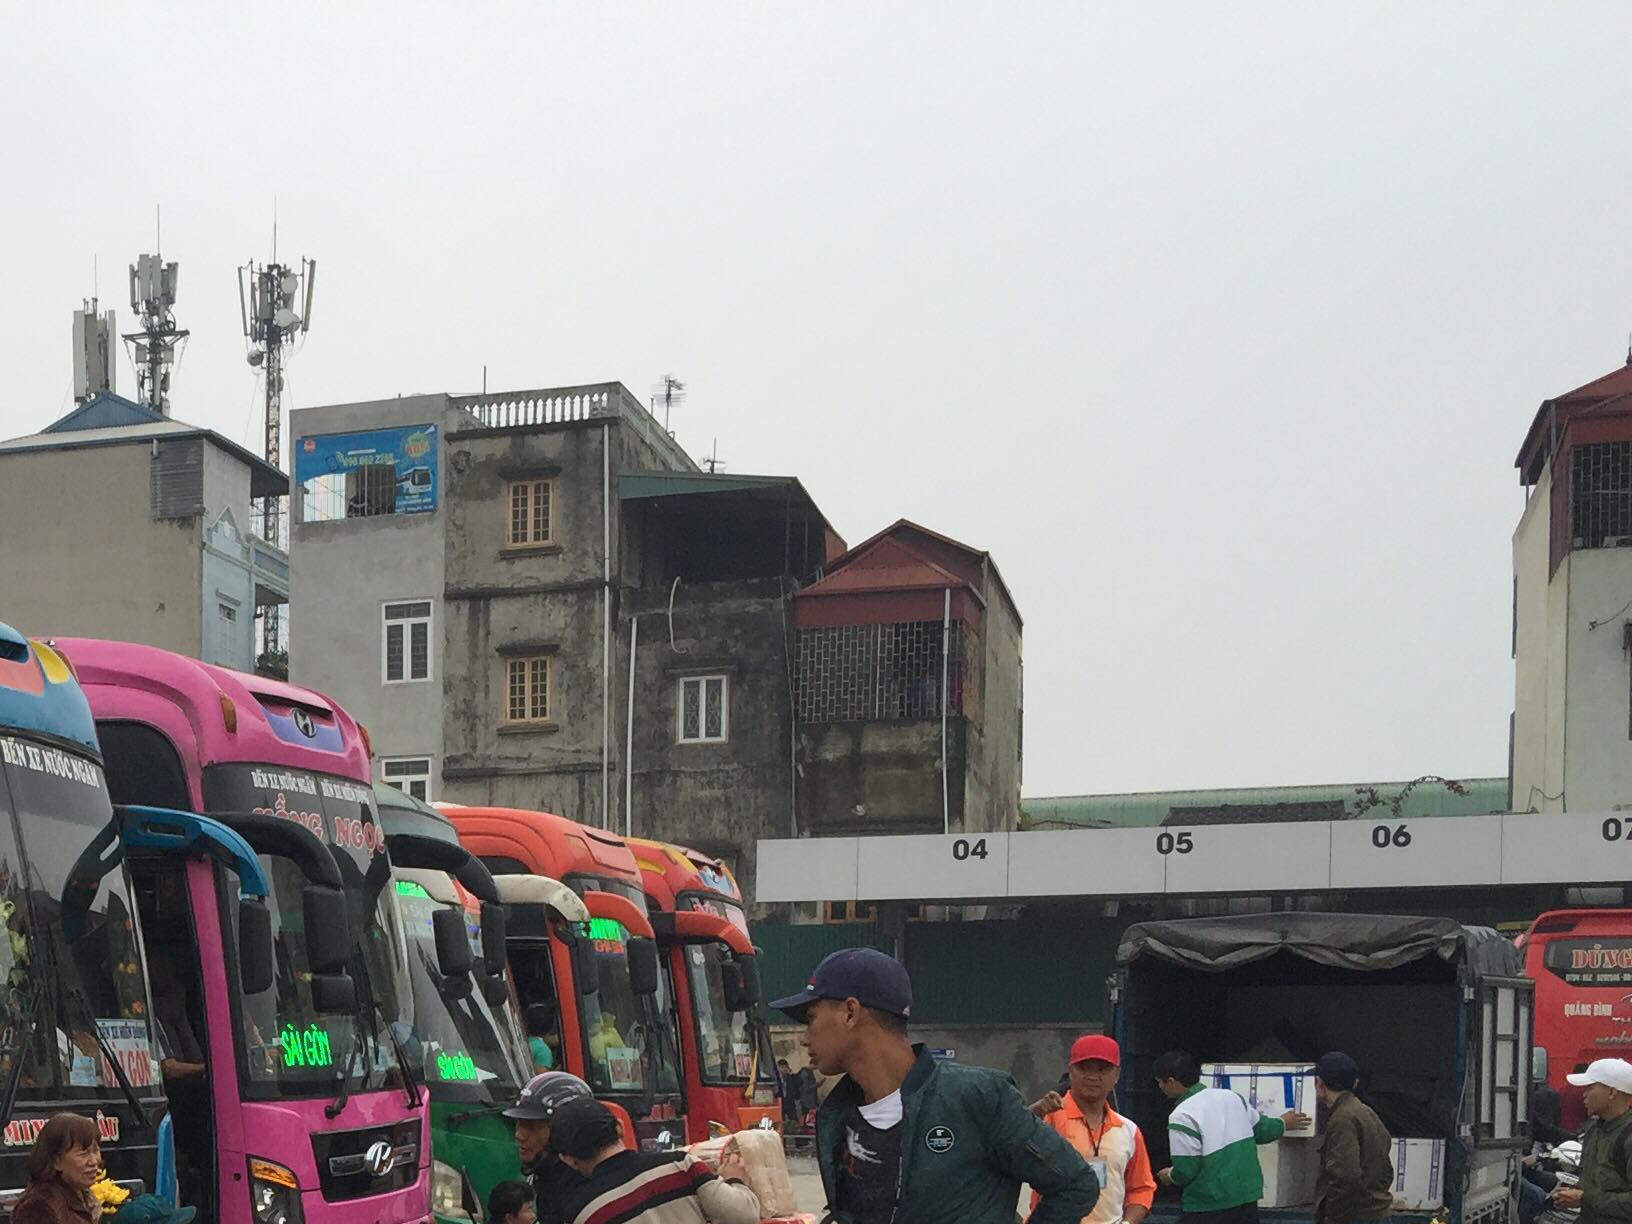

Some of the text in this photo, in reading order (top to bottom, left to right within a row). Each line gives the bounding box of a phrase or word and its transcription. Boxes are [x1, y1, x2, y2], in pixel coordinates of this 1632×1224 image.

[25, 745, 45, 772] XE
[1156, 831, 1194, 855] 05
[1372, 824, 1413, 849] 06
[952, 838, 989, 861] 04
[281, 1023, 333, 1067] SÀI GÒN
